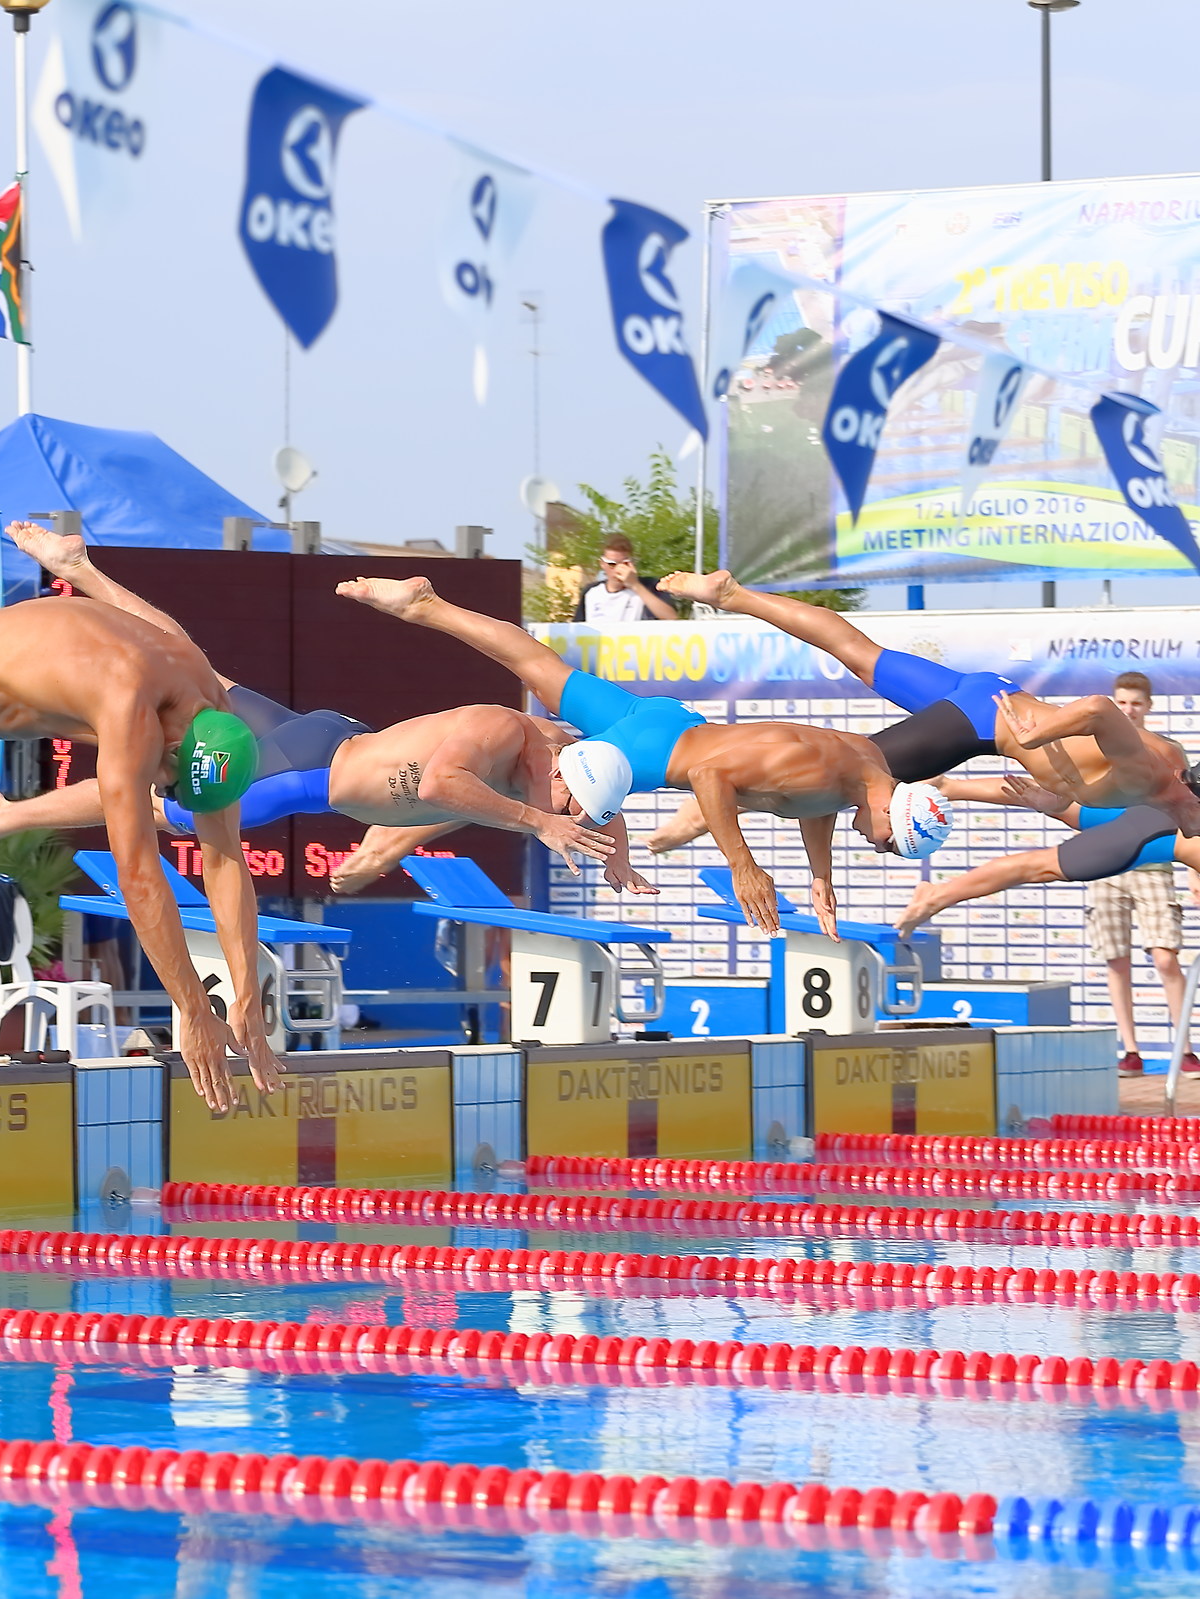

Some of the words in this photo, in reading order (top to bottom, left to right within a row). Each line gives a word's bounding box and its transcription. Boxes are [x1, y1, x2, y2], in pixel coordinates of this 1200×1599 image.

[991, 260, 1129, 312] TREVISO
[623, 312, 688, 356] OK
[832, 405, 884, 450] OK
[915, 502, 945, 519] 1/2
[952, 498, 1028, 517] LUGLIO
[1034, 496, 1086, 515] 2016
[1127, 477, 1177, 509] OK
[863, 527, 970, 550] MEETING
[576, 634, 707, 682] TREVISO
[712, 632, 815, 684] SWIM
[1049, 638, 1183, 660] NATATORIUM
[192, 741, 207, 758] LE
[191, 762, 202, 795] CLOS
[200, 755, 212, 779] RSA
[388, 776, 397, 789] Do
[399, 769, 412, 796] Dream
[579, 757, 597, 784] Sanlam
[530, 971, 560, 1027] 7
[802, 967, 832, 1019] 8
[855, 966, 873, 1019] 8
[690, 999, 710, 1035] 2
[557, 1061, 724, 1102] DAKTRONICS
[835, 1049, 971, 1086] DAKTRONICS
